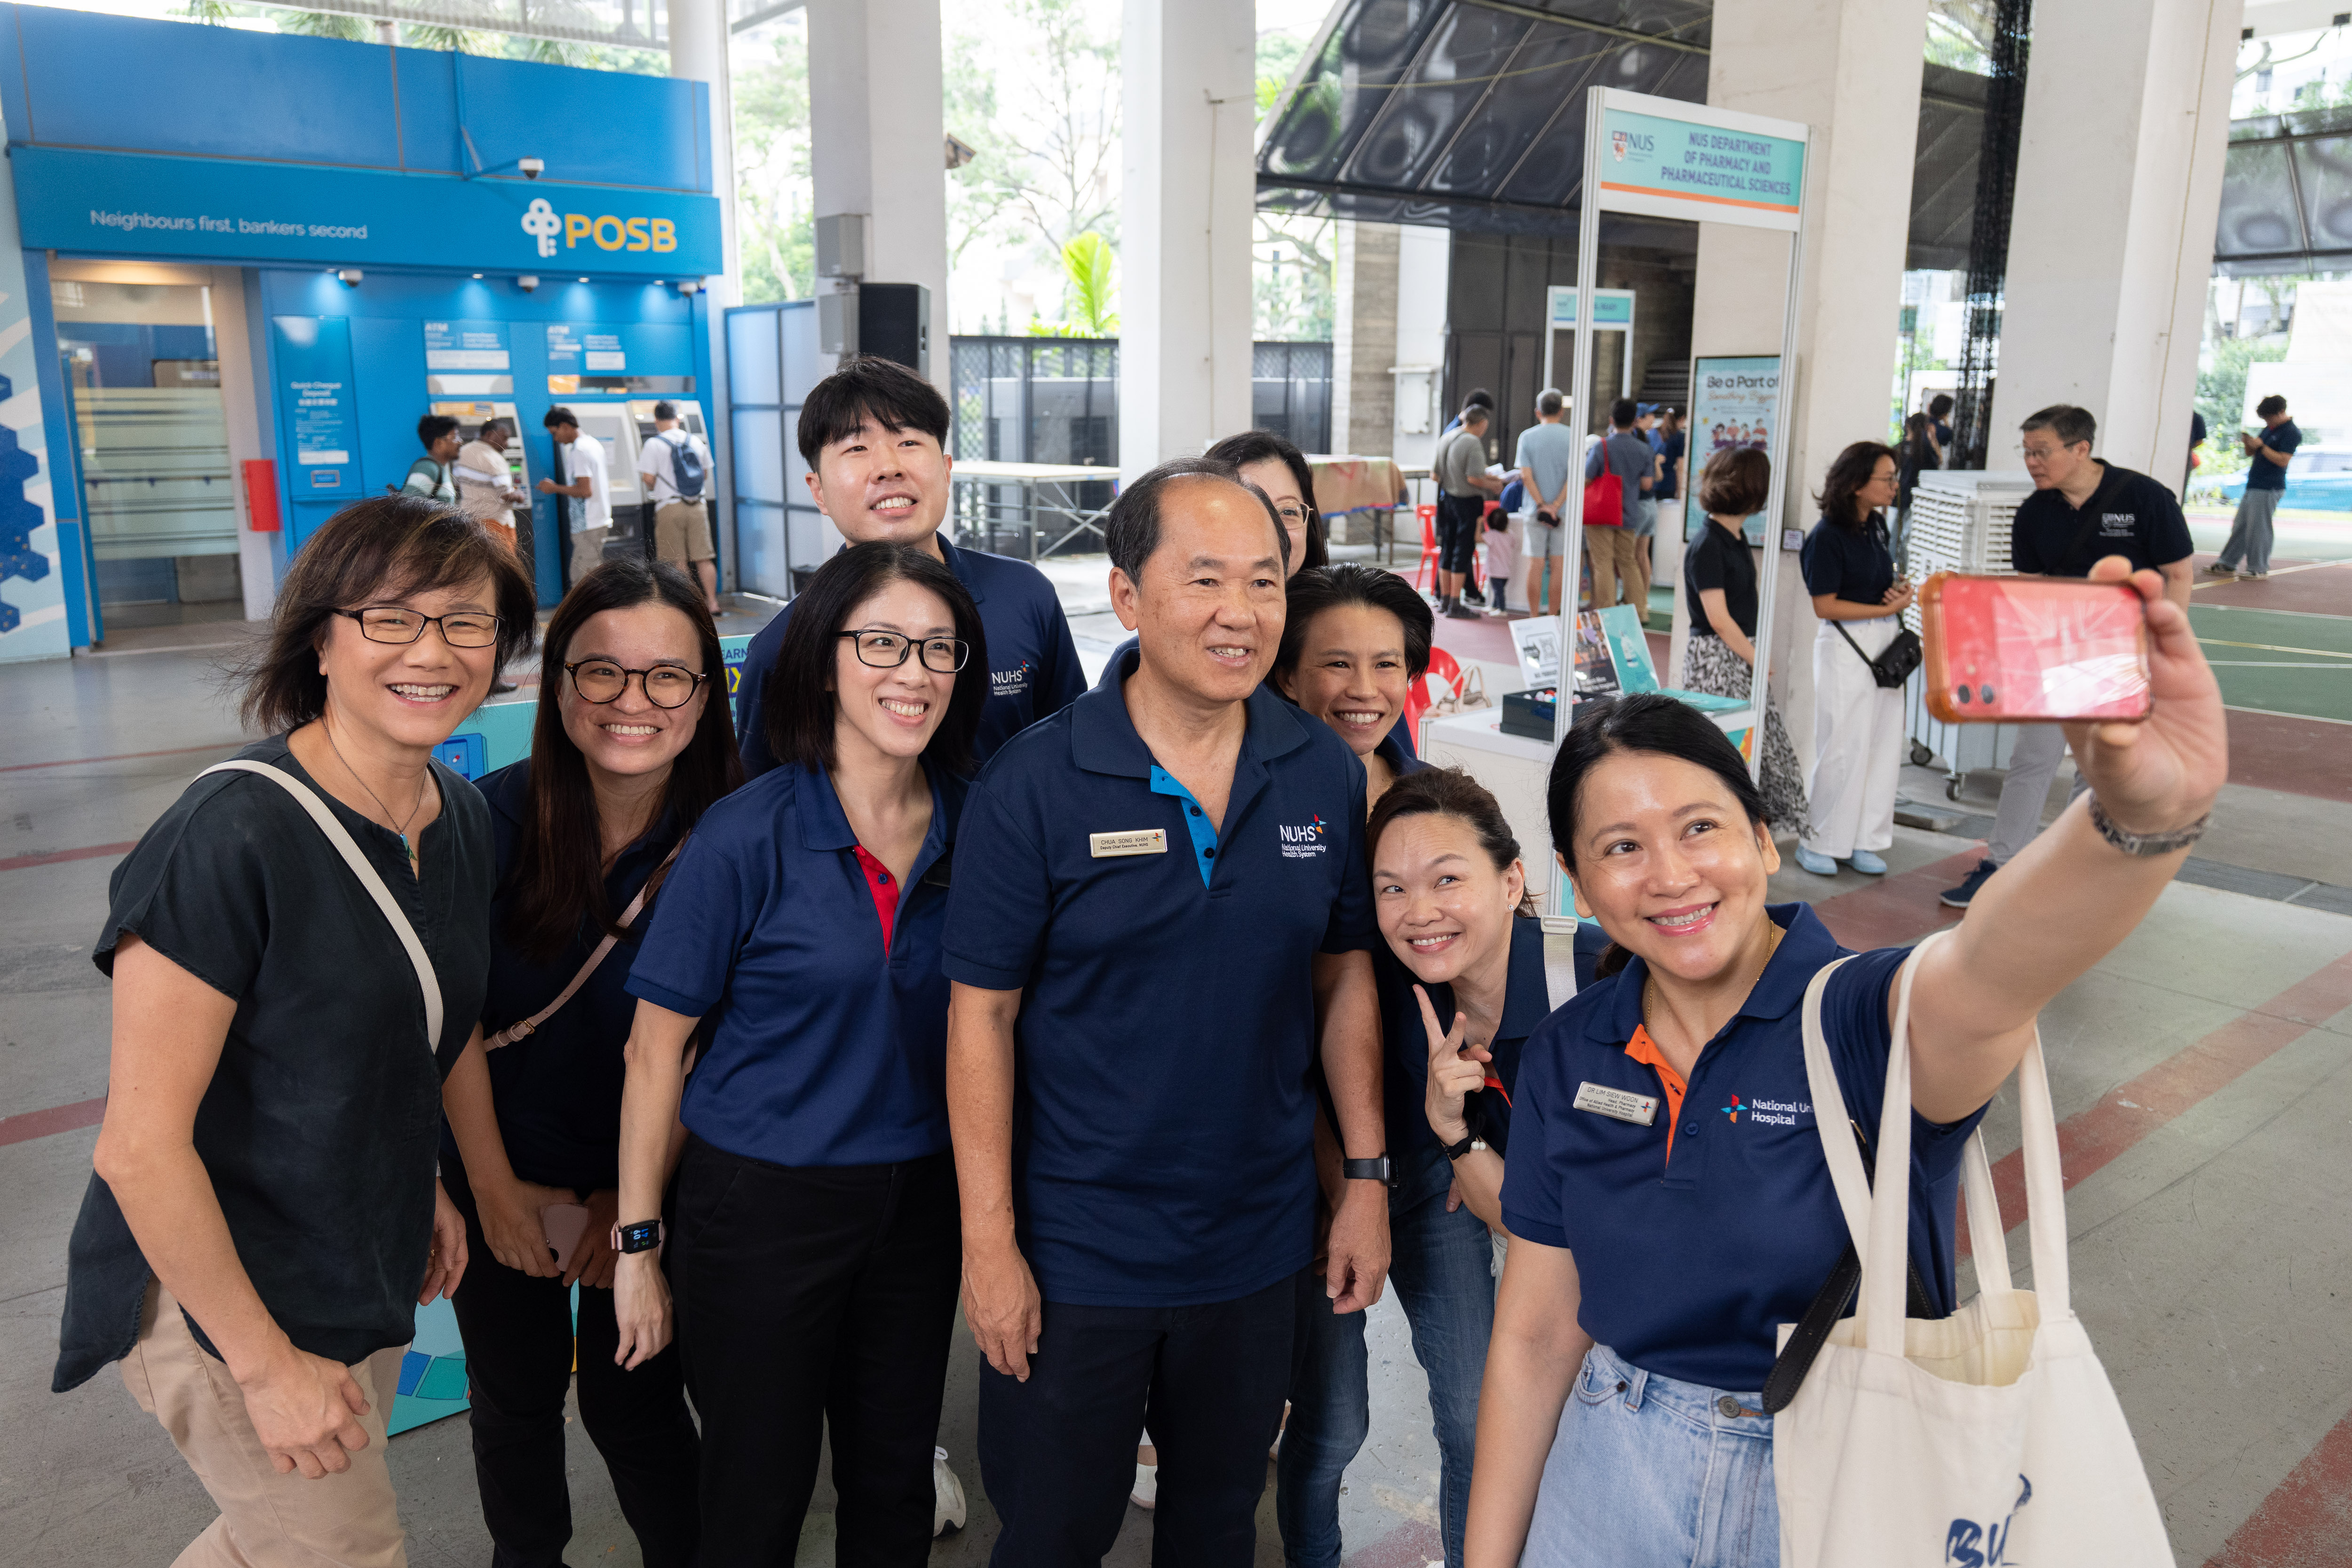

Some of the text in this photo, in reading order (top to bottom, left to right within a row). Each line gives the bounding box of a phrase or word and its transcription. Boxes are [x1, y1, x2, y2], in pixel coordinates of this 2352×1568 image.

[1628, 132, 1654, 151] NUS
[1689, 131, 1772, 157] NUS DEPARTMENT
[1684, 150, 1772, 175] OF PHARMACY AND
[1661, 166, 1791, 196] PHARMACEUTICAL SCIENCES
[90, 210, 196, 231] Neighbours
[238, 217, 306, 237] bankers
[308, 224, 368, 239] second
[564, 213, 678, 253] POSB
[1707, 375, 1723, 389] Be
[1724, 378, 1734, 389] a
[1736, 375, 1764, 389] Part
[2114, 513, 2135, 523] NUS
[991, 669, 1023, 684] NUHS
[1279, 825, 1316, 842] NUHS
[1282, 843, 1327, 852] National University
[1619, 1100, 1636, 1109] Pharmacy
[1621, 1094, 1639, 1103] WOON
[1752, 1098, 1798, 1113] National
[1751, 1111, 1795, 1126] Hospital
